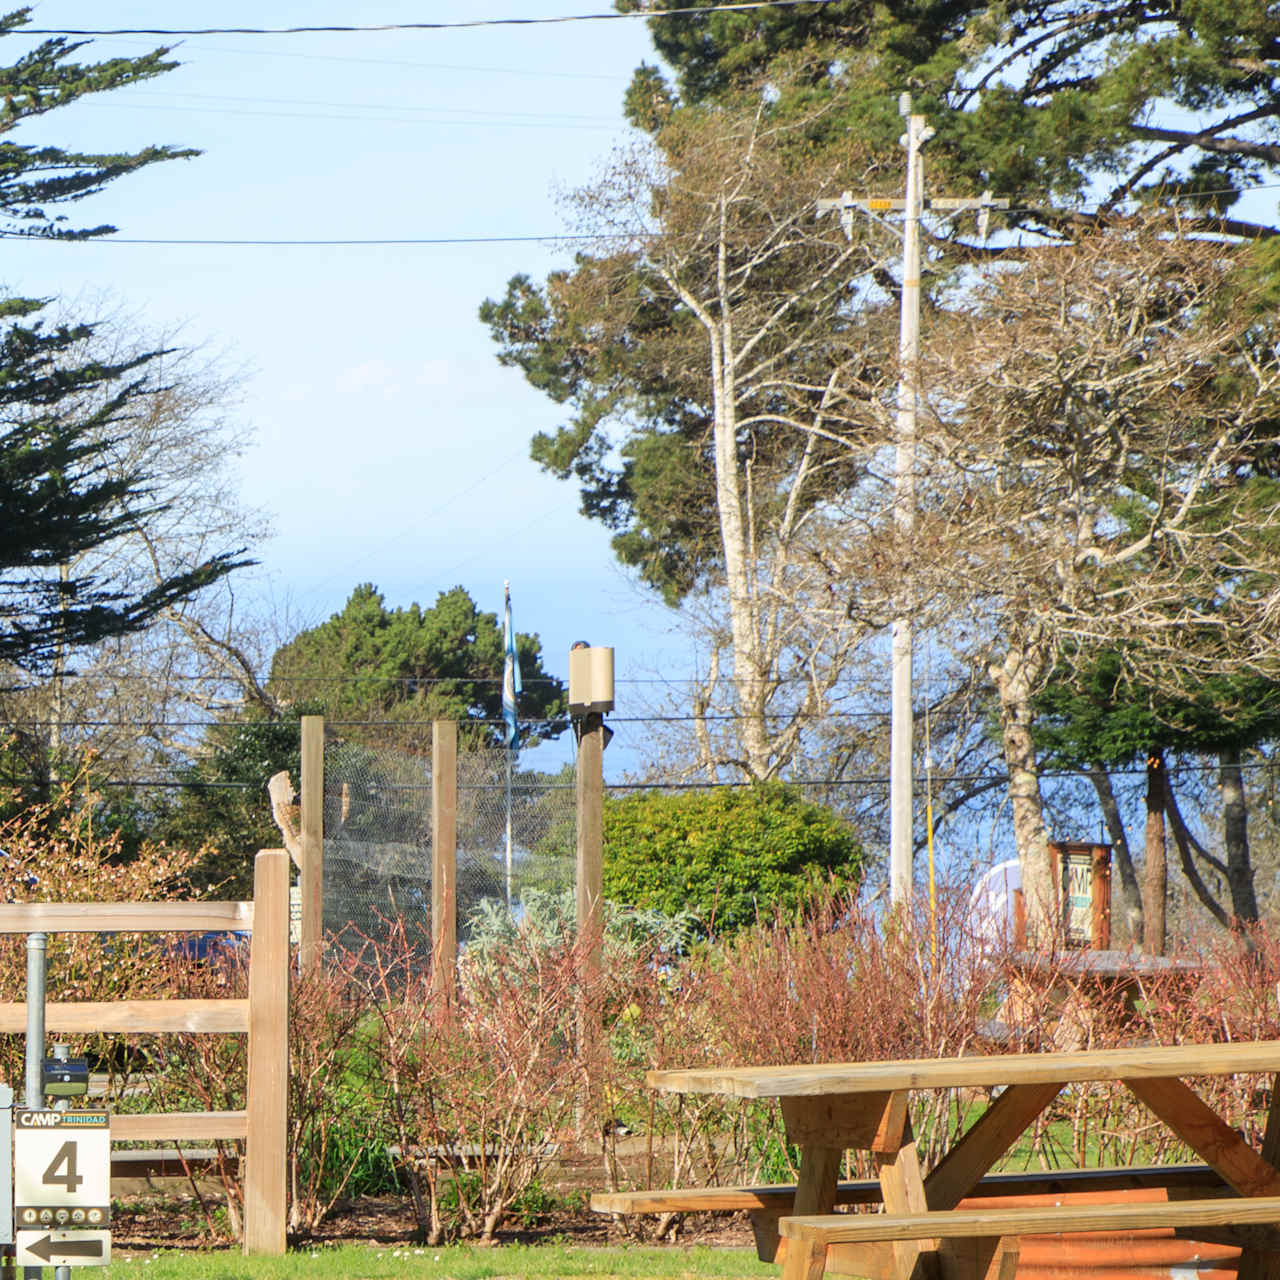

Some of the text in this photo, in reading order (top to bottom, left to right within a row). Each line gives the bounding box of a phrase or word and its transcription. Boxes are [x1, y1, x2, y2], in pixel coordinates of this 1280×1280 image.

[20, 1113, 105, 1126] CAMP TRINIDAD
[42, 1141, 83, 1192] 4
